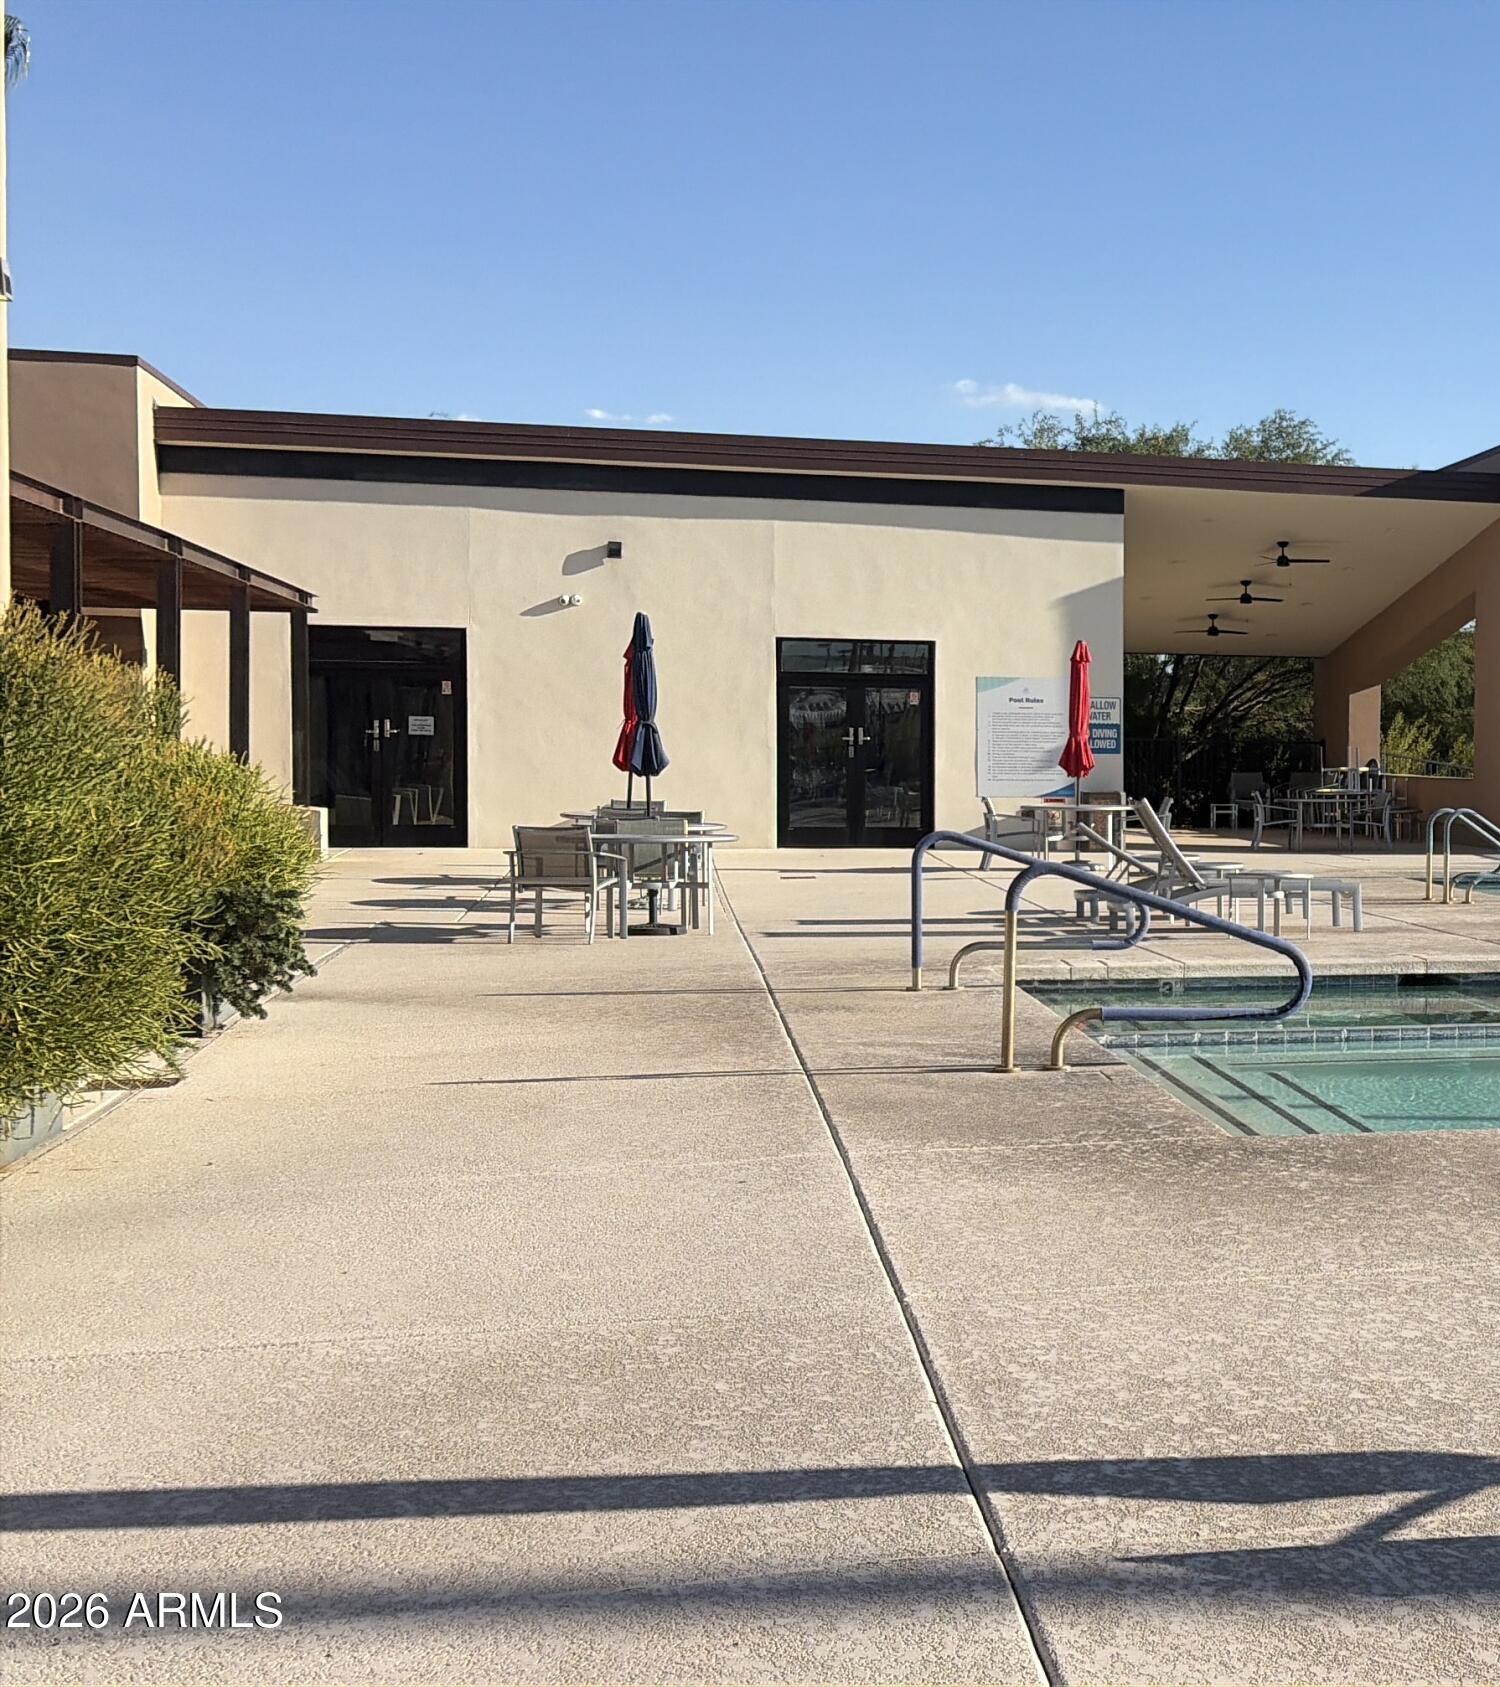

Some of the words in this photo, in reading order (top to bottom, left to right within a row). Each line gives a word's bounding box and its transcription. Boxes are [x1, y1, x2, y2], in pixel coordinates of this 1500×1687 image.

[1090, 701, 1116, 710] ALLOW
[1090, 711, 1111, 721] ATER
[1092, 729, 1118, 738] DIVING
[1090, 740, 1116, 749] LOWED
